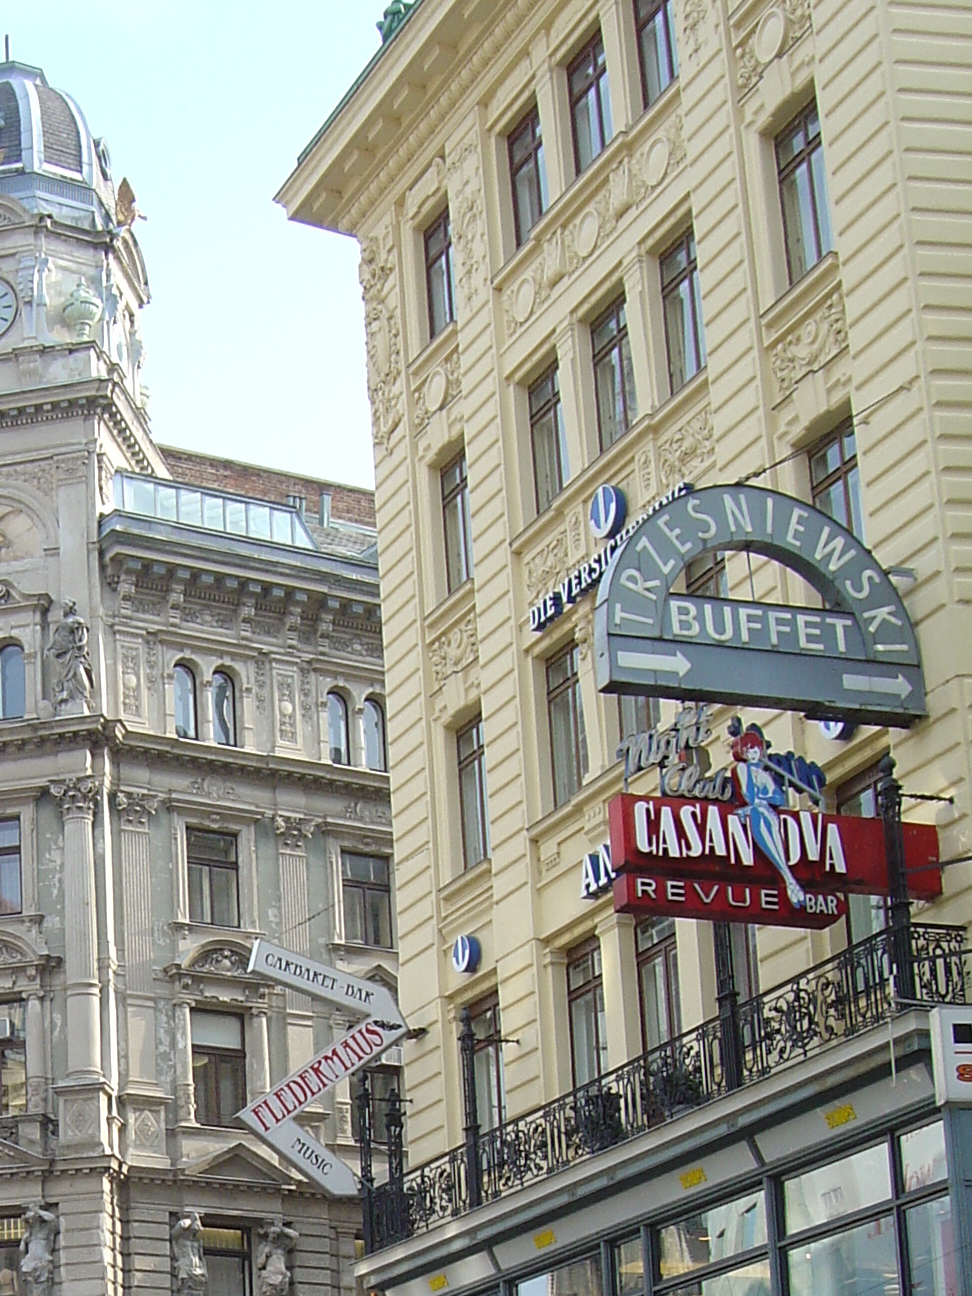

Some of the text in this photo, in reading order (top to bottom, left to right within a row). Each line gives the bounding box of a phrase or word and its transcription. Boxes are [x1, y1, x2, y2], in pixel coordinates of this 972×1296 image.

[529, 592, 556, 631] DIE
[669, 600, 853, 654] BUFFET
[633, 800, 847, 874] CASANOVA
[636, 878, 838, 915] REVUE BAR
[250, 1019, 385, 1133] FLEDERMAUS
[291, 1138, 333, 1176] MUSIC
